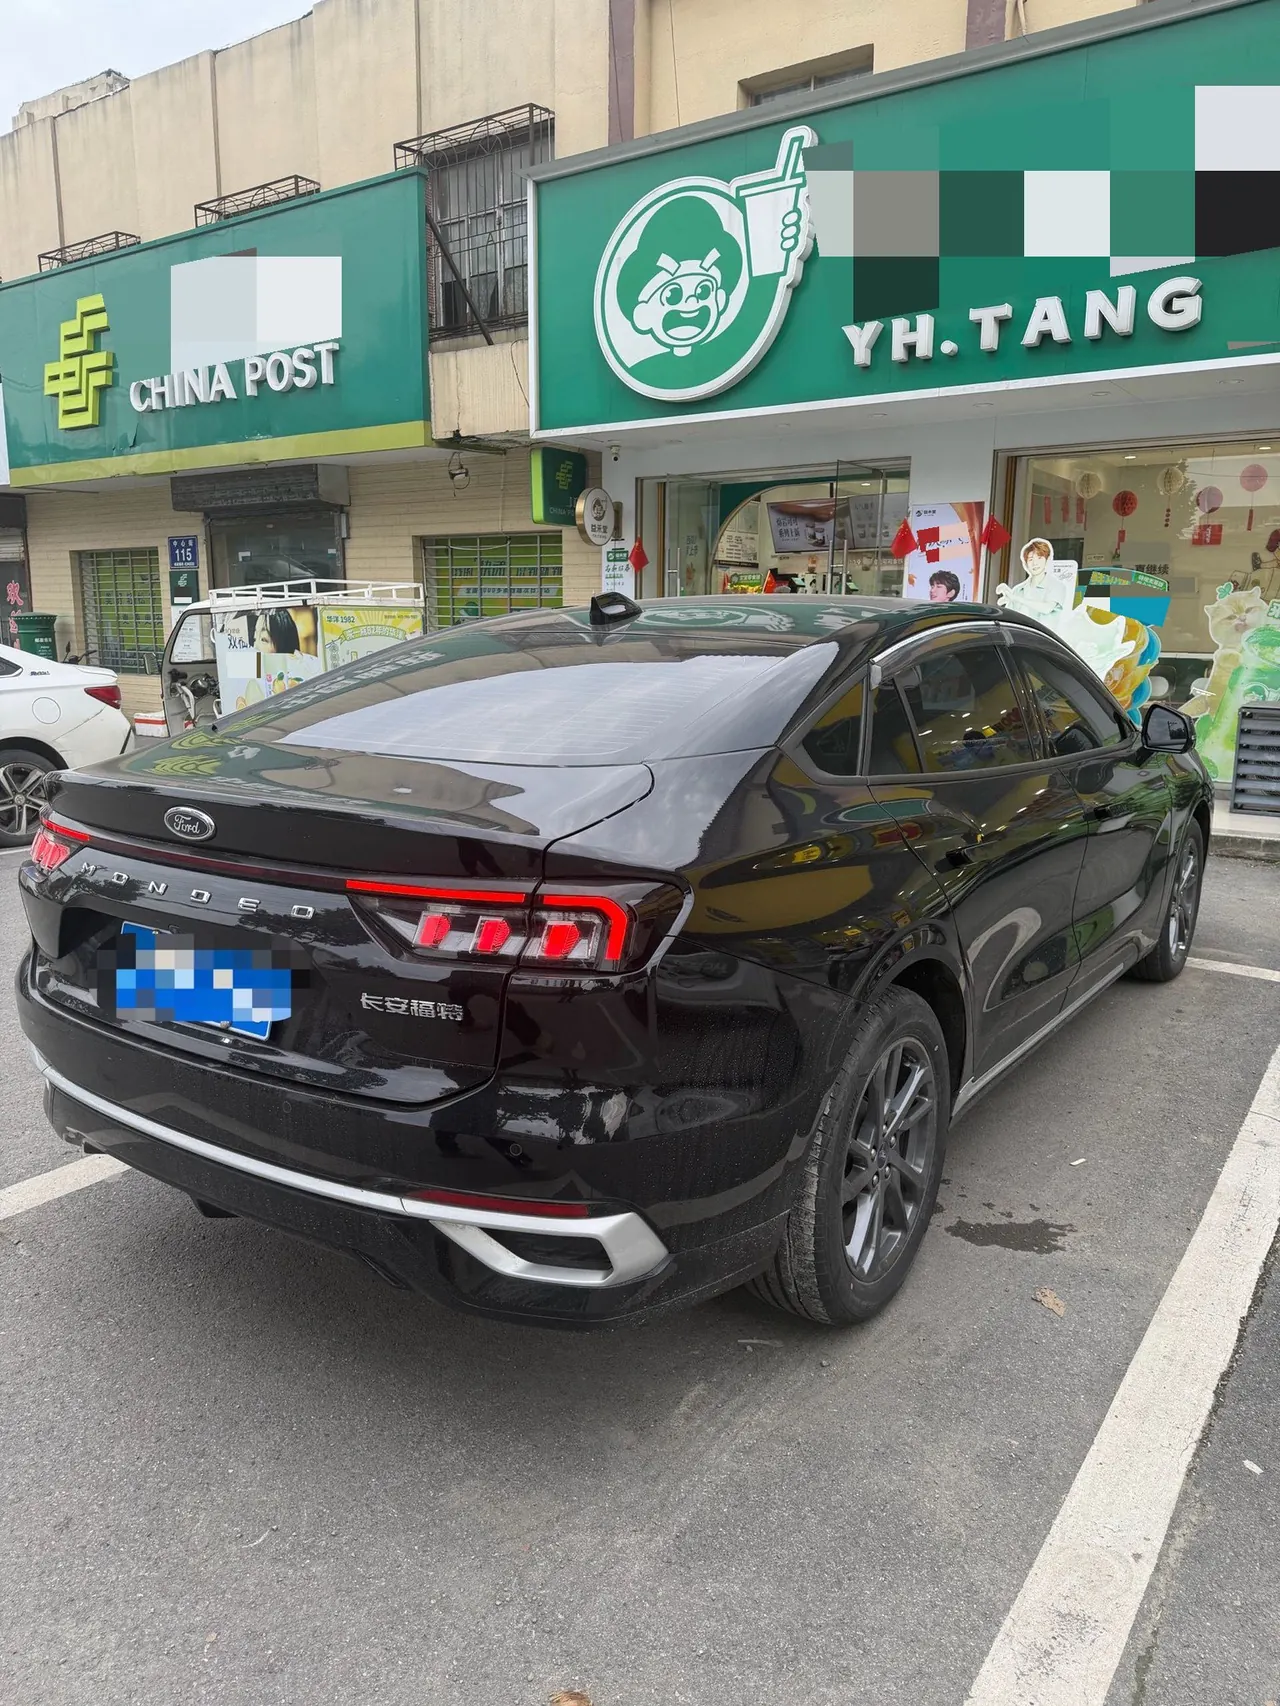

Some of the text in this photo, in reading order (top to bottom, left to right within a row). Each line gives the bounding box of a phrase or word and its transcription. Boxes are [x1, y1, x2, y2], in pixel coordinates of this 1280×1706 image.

[842, 276, 1202, 368] YH.TANG
[130, 342, 339, 412] CHINA POST
[175, 548, 192, 562] 115
[340, 615, 355, 624] 1982
[173, 814, 200, 835] Ford
[80, 861, 316, 920] MONDEO
[360, 992, 464, 1022] 长安福特
